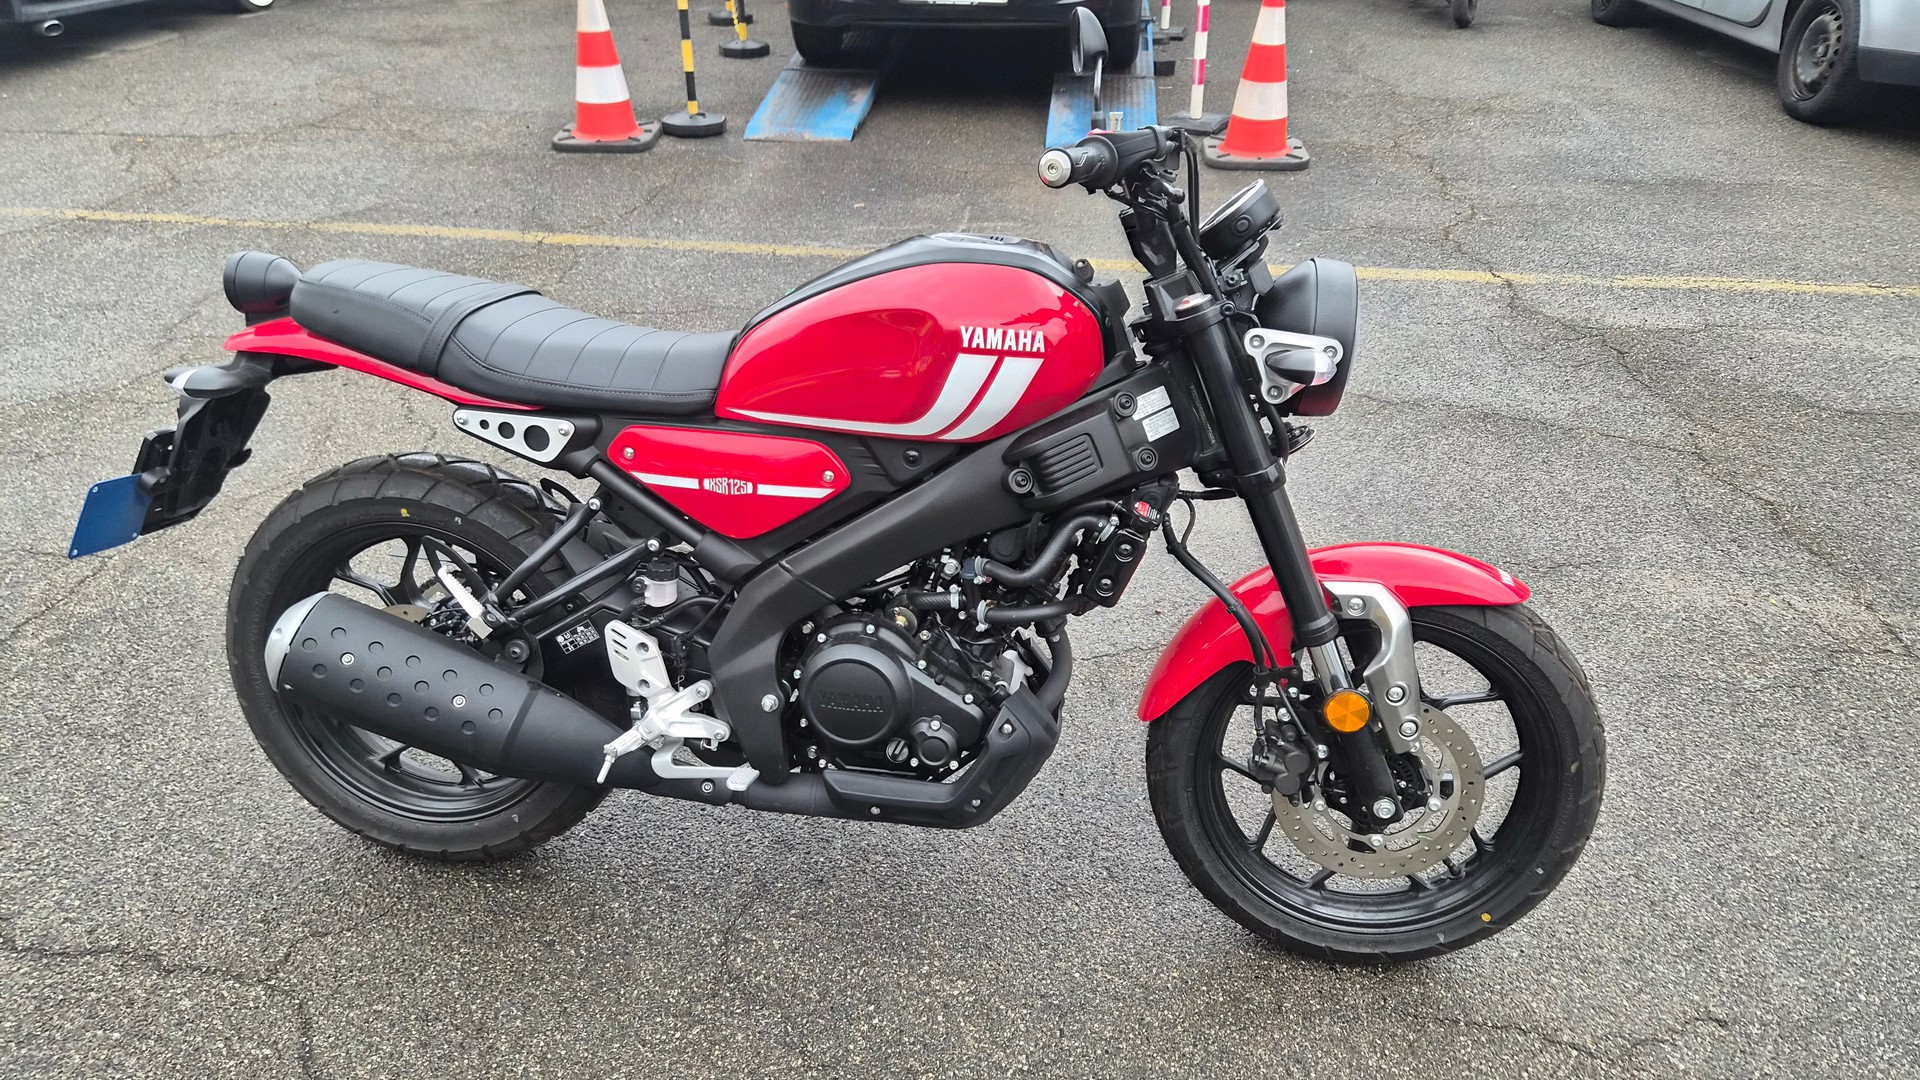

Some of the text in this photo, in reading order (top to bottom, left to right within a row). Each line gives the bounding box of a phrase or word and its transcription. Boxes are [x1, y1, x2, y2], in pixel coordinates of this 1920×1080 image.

[960, 325, 1045, 353] YAMAHA
[709, 477, 748, 495] XSR125
[818, 689, 884, 713] YAMAHA
